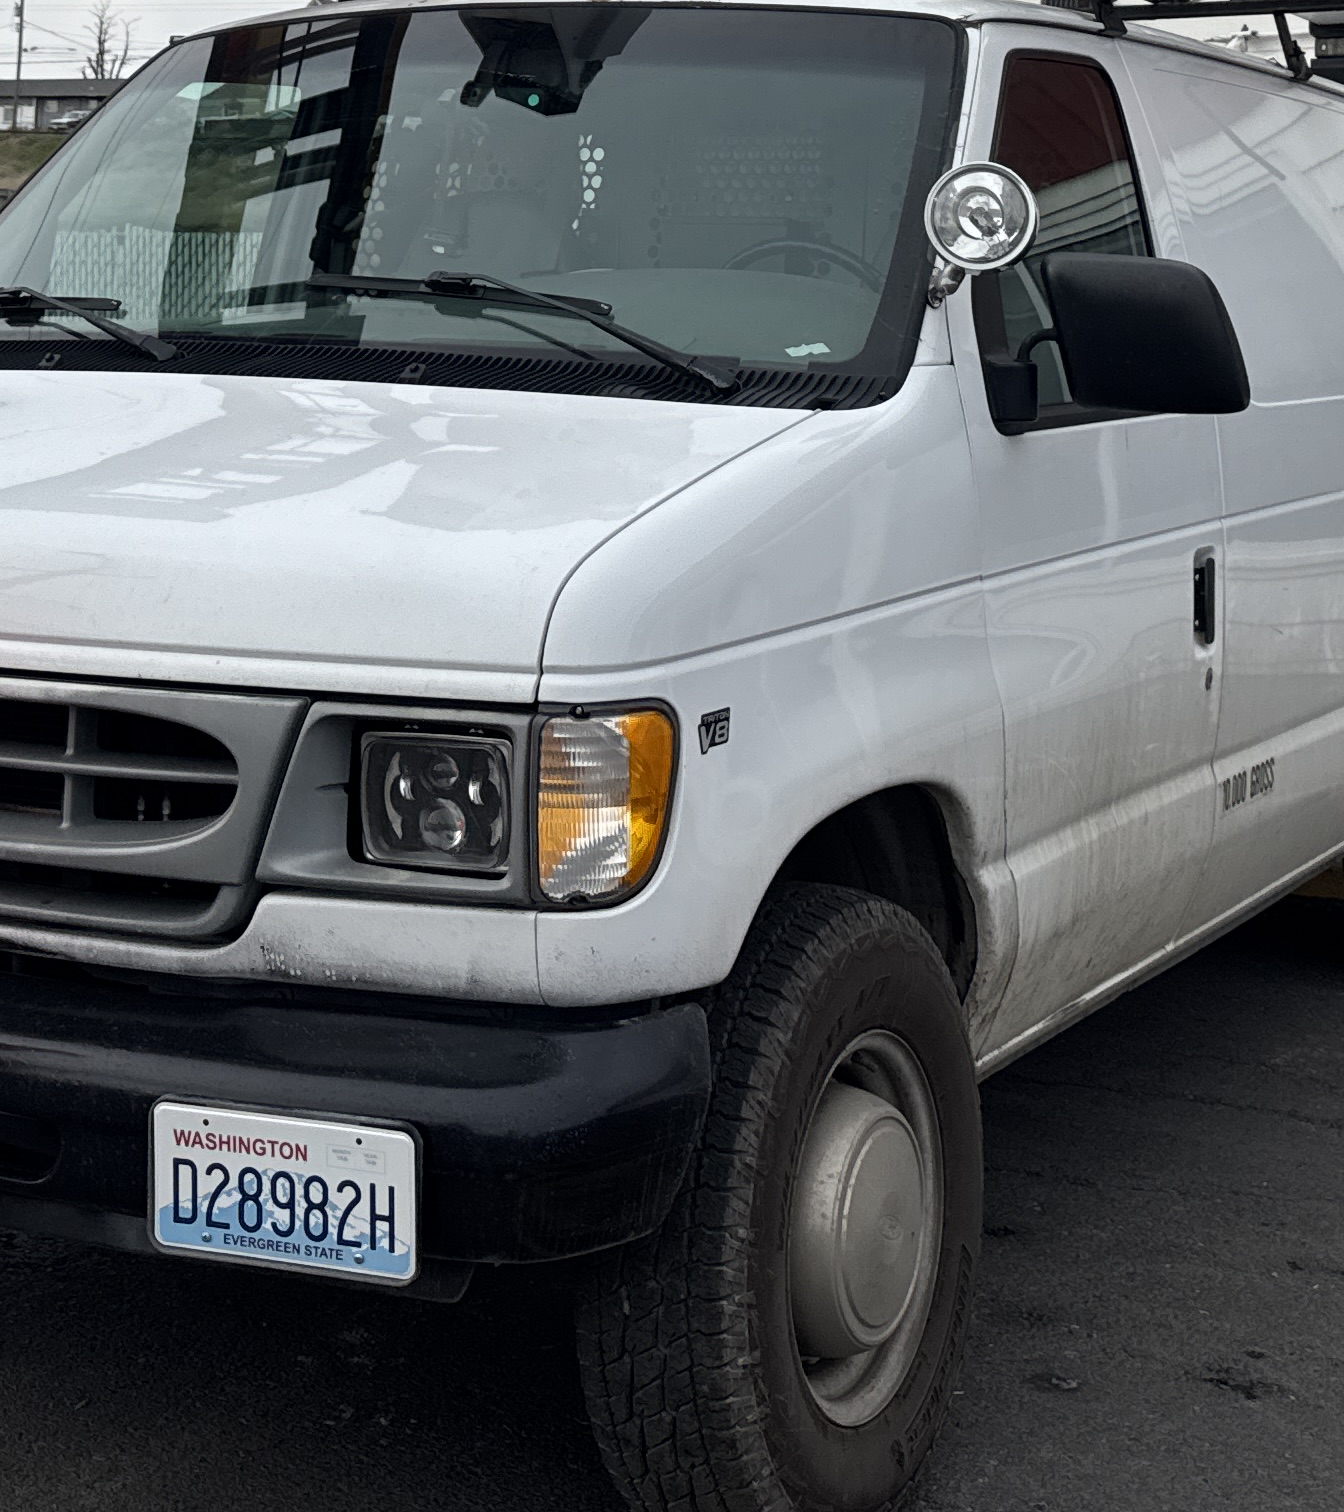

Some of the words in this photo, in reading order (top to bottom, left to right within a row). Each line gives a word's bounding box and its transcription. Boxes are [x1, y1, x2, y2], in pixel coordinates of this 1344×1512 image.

[700, 721, 729, 752] V8
[173, 1129, 308, 1162] WASHINGTON
[173, 1157, 395, 1253] D28982H
[223, 1233, 301, 1255] EVERGREEN
[304, 1245, 344, 1260] STATE
